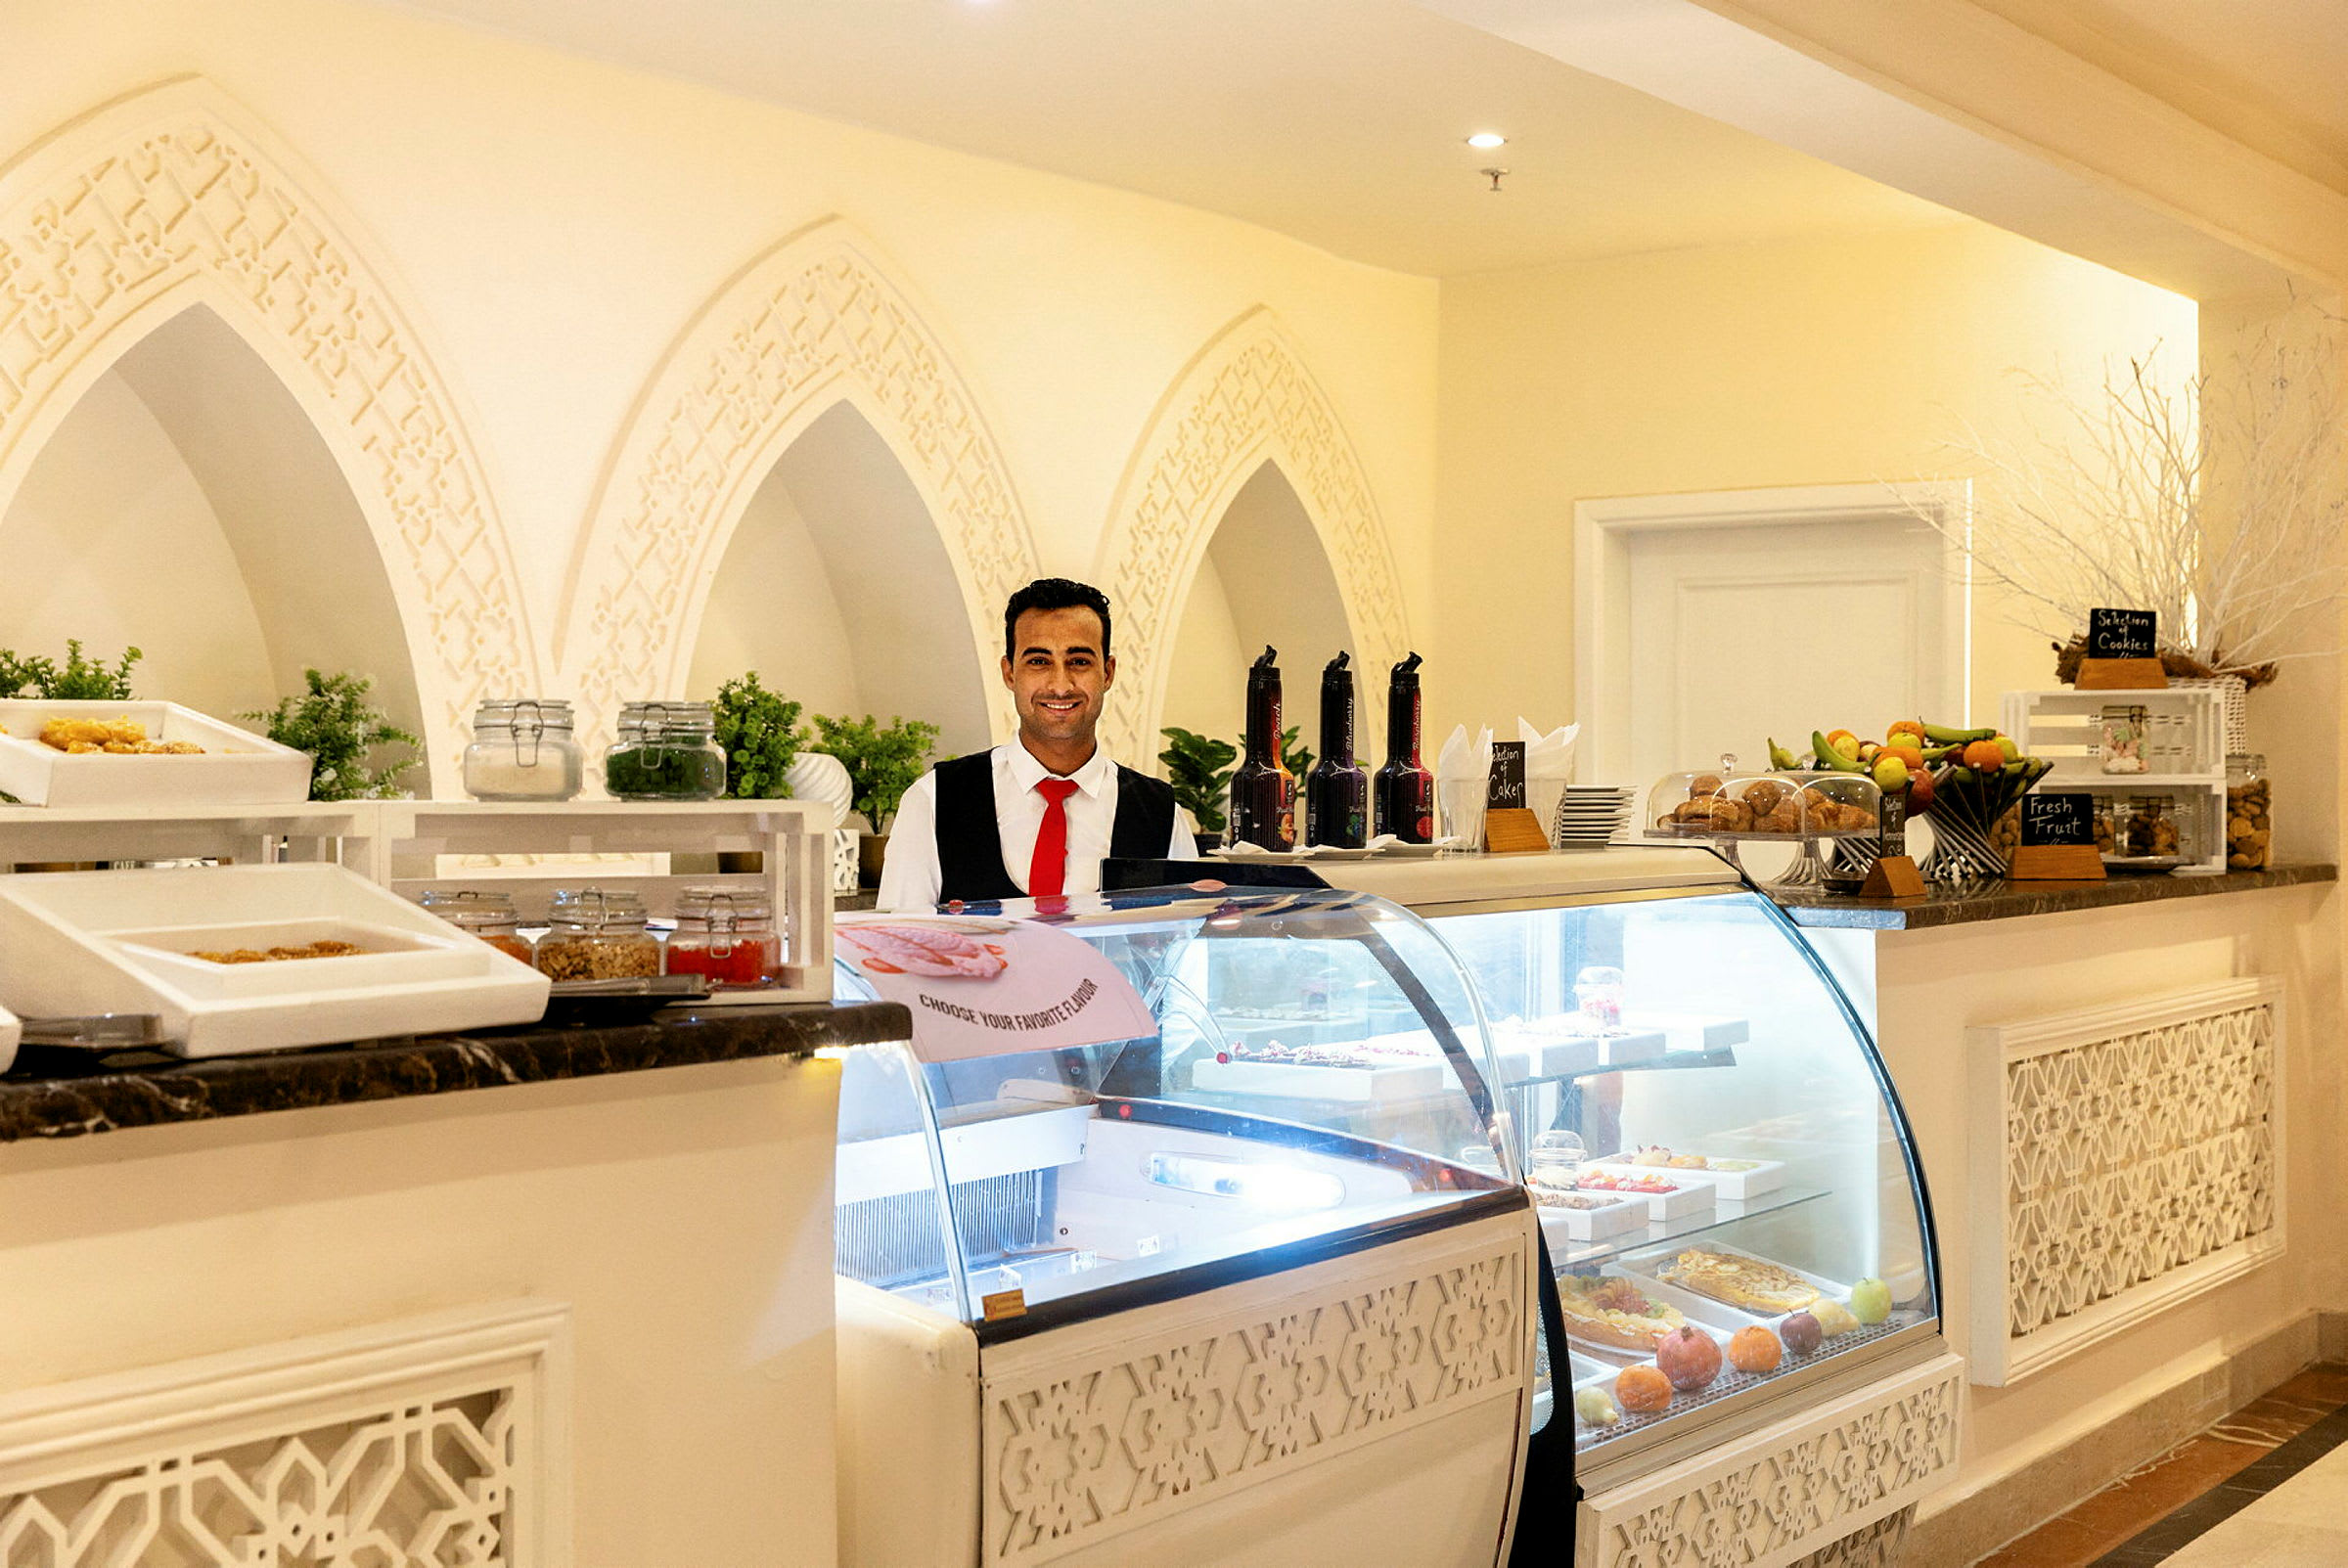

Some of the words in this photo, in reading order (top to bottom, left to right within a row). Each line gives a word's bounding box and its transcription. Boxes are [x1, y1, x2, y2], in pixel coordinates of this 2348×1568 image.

[2098, 609, 2149, 627] Selection
[2098, 632, 2149, 651] Cookies
[2118, 626, 2129, 641] of
[1273, 702, 1282, 739] Peach
[1345, 697, 1354, 751] Blueberry
[1488, 774, 1523, 808] Cakes
[2030, 795, 2073, 815] Fresh
[2028, 814, 2082, 836] Fruit
[919, 993, 978, 1024] CHOOSE
[979, 1010, 1017, 1031] YOUR
[1015, 1006, 1068, 1032] FAVORITE
[1063, 977, 1100, 1020] FLAVOUR
